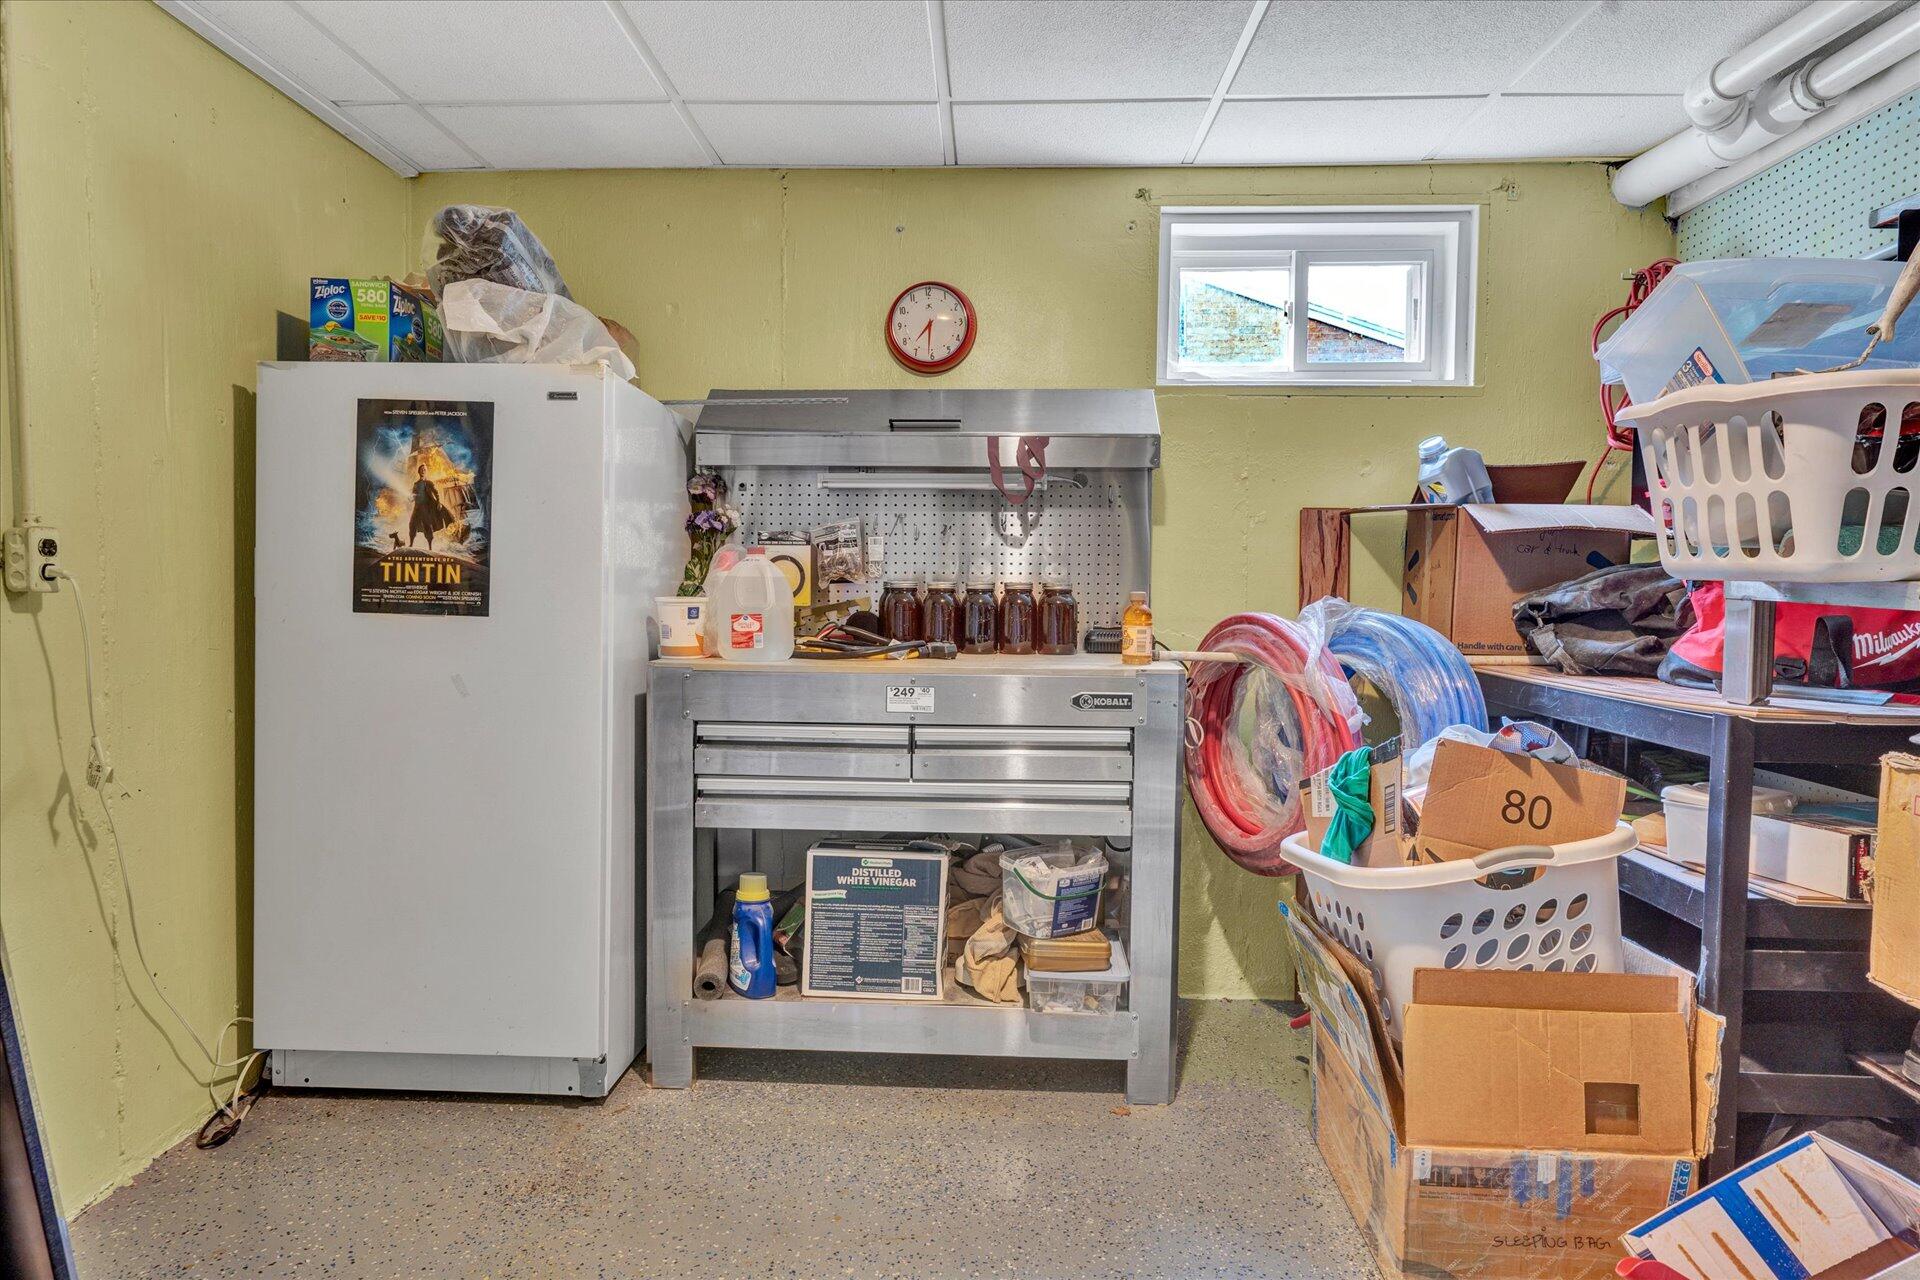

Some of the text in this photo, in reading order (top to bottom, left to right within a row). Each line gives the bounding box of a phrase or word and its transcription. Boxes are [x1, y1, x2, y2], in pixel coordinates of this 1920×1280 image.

[314, 285, 345, 299] Ziploc
[357, 289, 387, 303] 580
[925, 287, 932, 297] 12
[943, 292, 948, 300] 1
[909, 293, 916, 302] 11
[393, 295, 416, 316] Ziploc
[953, 303, 959, 311] 2
[899, 306, 906, 315] 10
[897, 322, 902, 330] 9
[958, 318, 963, 326] 3
[913, 348, 918, 356] 7
[946, 346, 951, 354] 5
[930, 351, 935, 360] 6
[1682, 360, 1692, 372] 3
[380, 562, 461, 584] TINTIN
[1457, 642, 1486, 650] Handle
[1487, 642, 1504, 650] with
[1094, 698, 1129, 706] KOBALT
[1501, 789, 1553, 830] 80
[852, 867, 902, 878] DISTILLED
[836, 876, 870, 886] WHITE
[871, 877, 917, 888] VINEGAR
[1491, 1226, 1612, 1250] SLEEPING BAG
